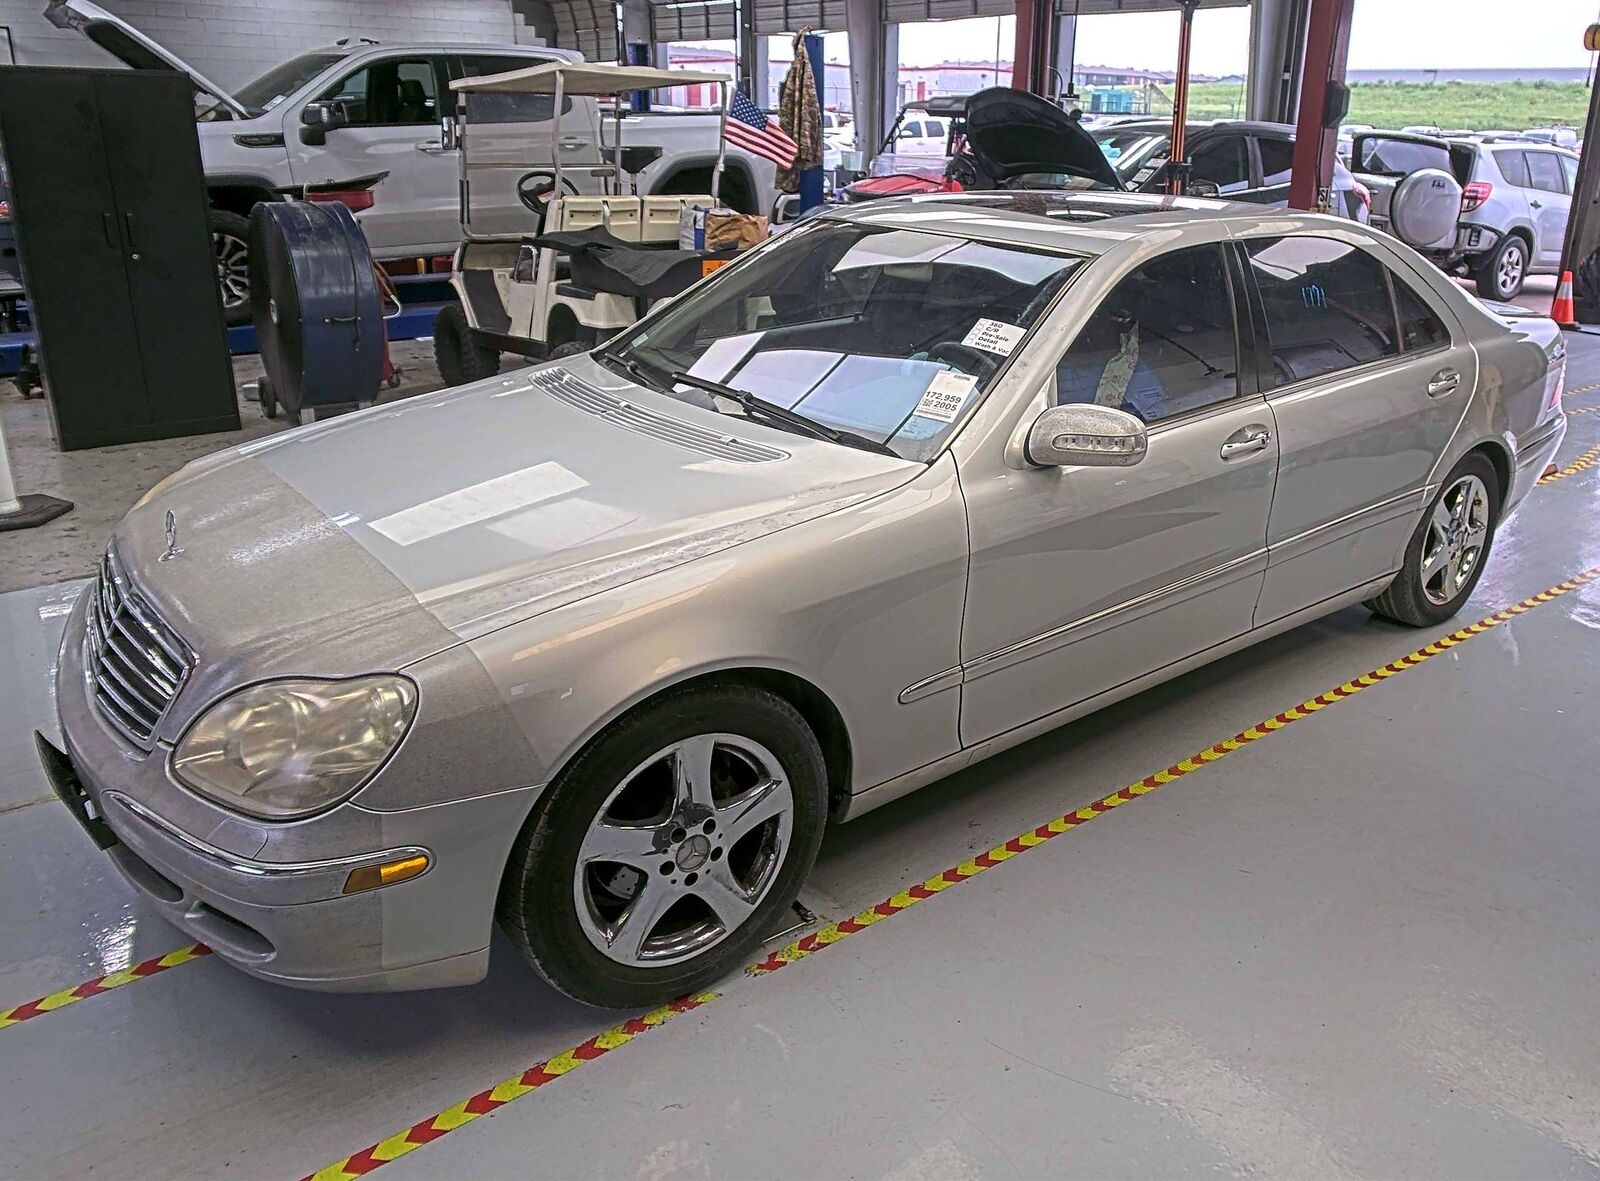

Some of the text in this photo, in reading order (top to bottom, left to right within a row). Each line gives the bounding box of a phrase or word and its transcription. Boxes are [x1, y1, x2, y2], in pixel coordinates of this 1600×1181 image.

[985, 326, 1000, 334] C/R
[989, 321, 1004, 329] 360
[977, 336, 999, 346] Detail
[981, 331, 1010, 343] Pre-Sale
[974, 341, 991, 350] Wash
[998, 347, 1010, 355] Vac
[933, 400, 958, 412] 2005
